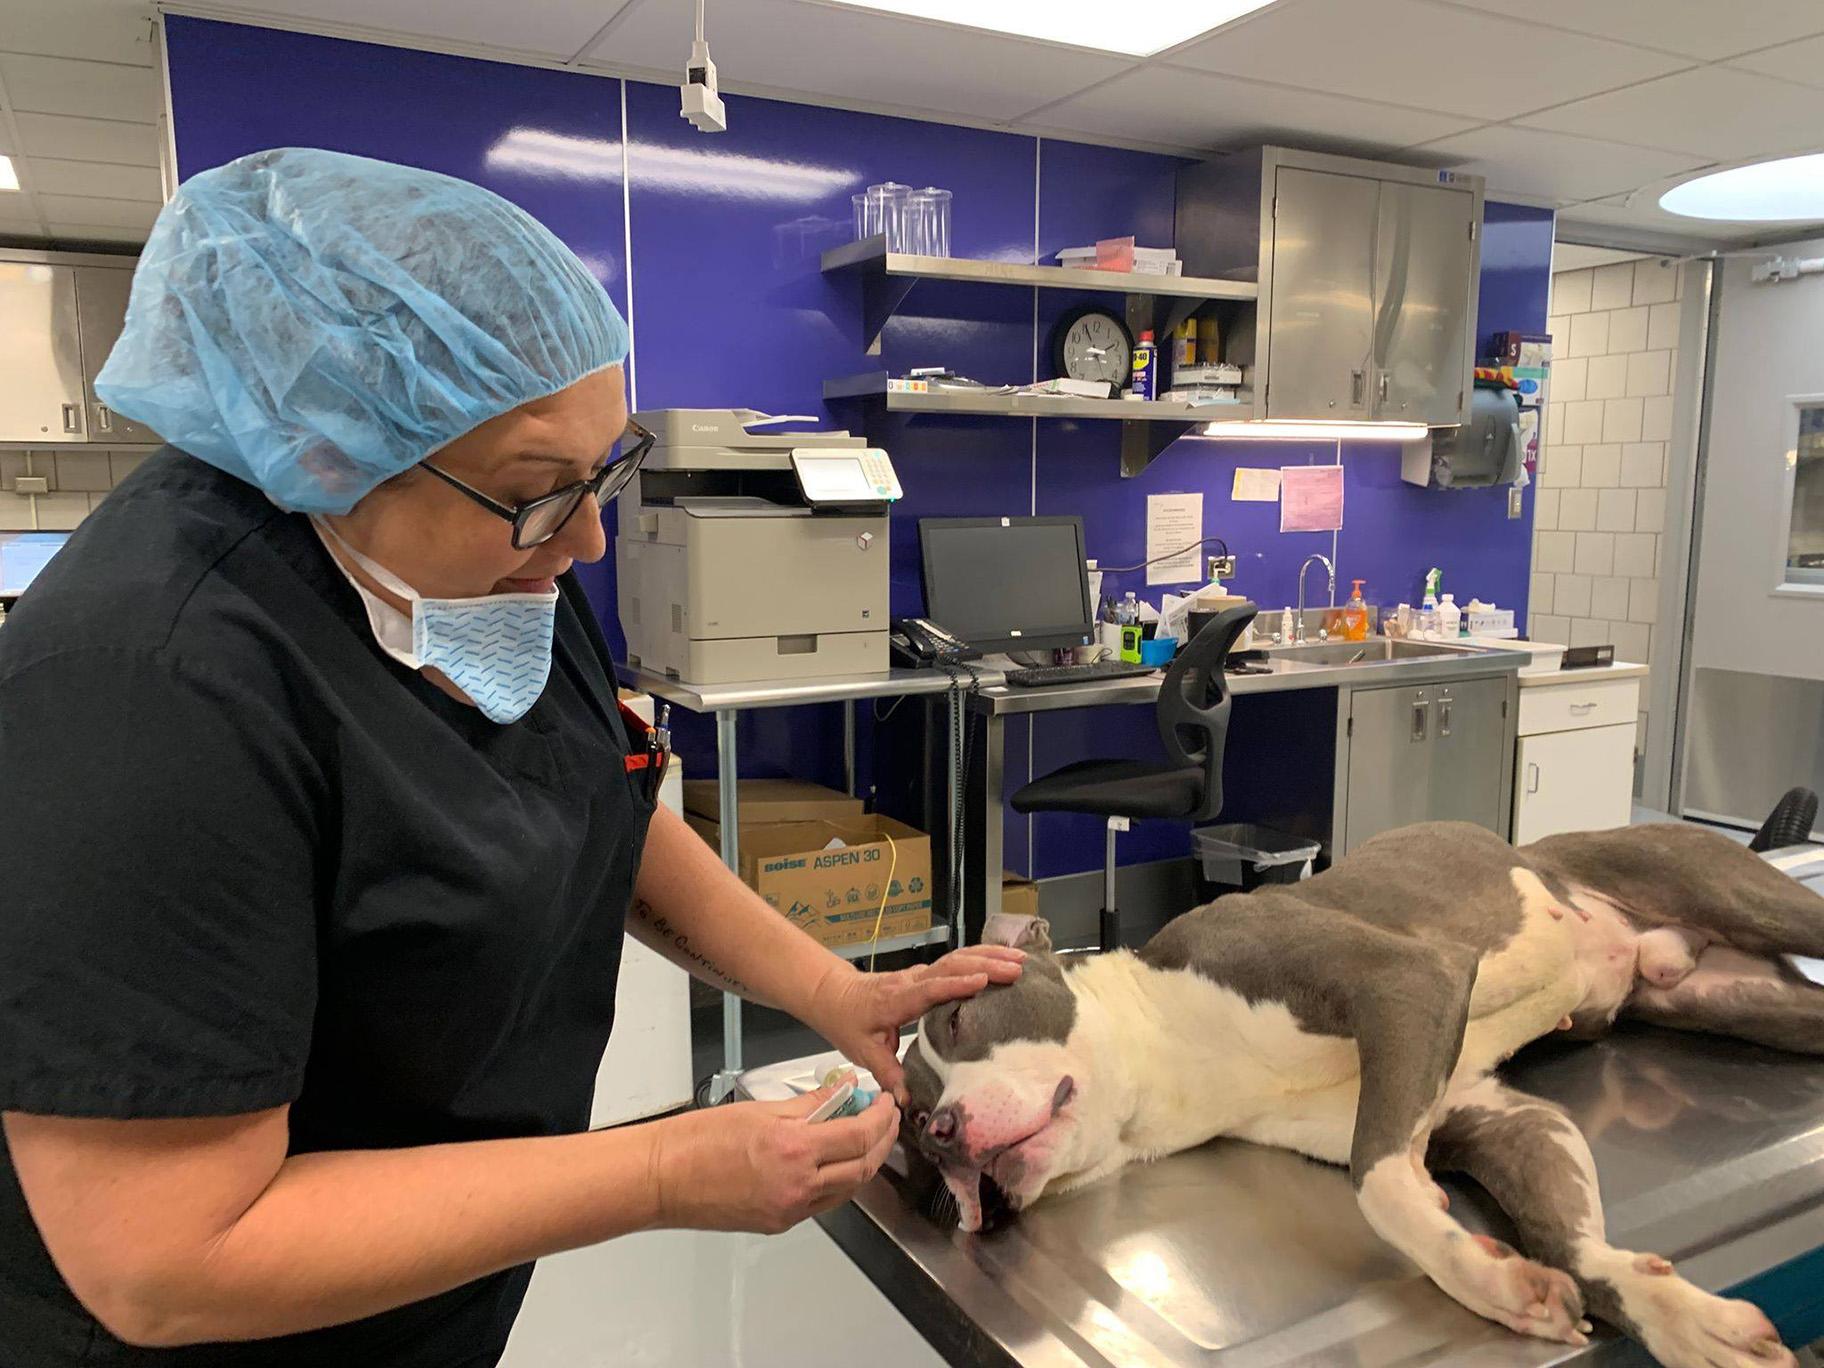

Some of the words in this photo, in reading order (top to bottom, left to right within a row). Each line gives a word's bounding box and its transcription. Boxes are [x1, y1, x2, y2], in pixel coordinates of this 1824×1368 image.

[1093, 321, 1101, 334] 12
[1071, 332, 1081, 344] 10
[1510, 343, 1517, 357] S
[1070, 362, 1077, 373] 8
[1112, 369, 1118, 381] 4
[691, 423, 719, 433] Canon
[813, 851, 860, 870] ASPEN
[863, 848, 881, 862] 30
